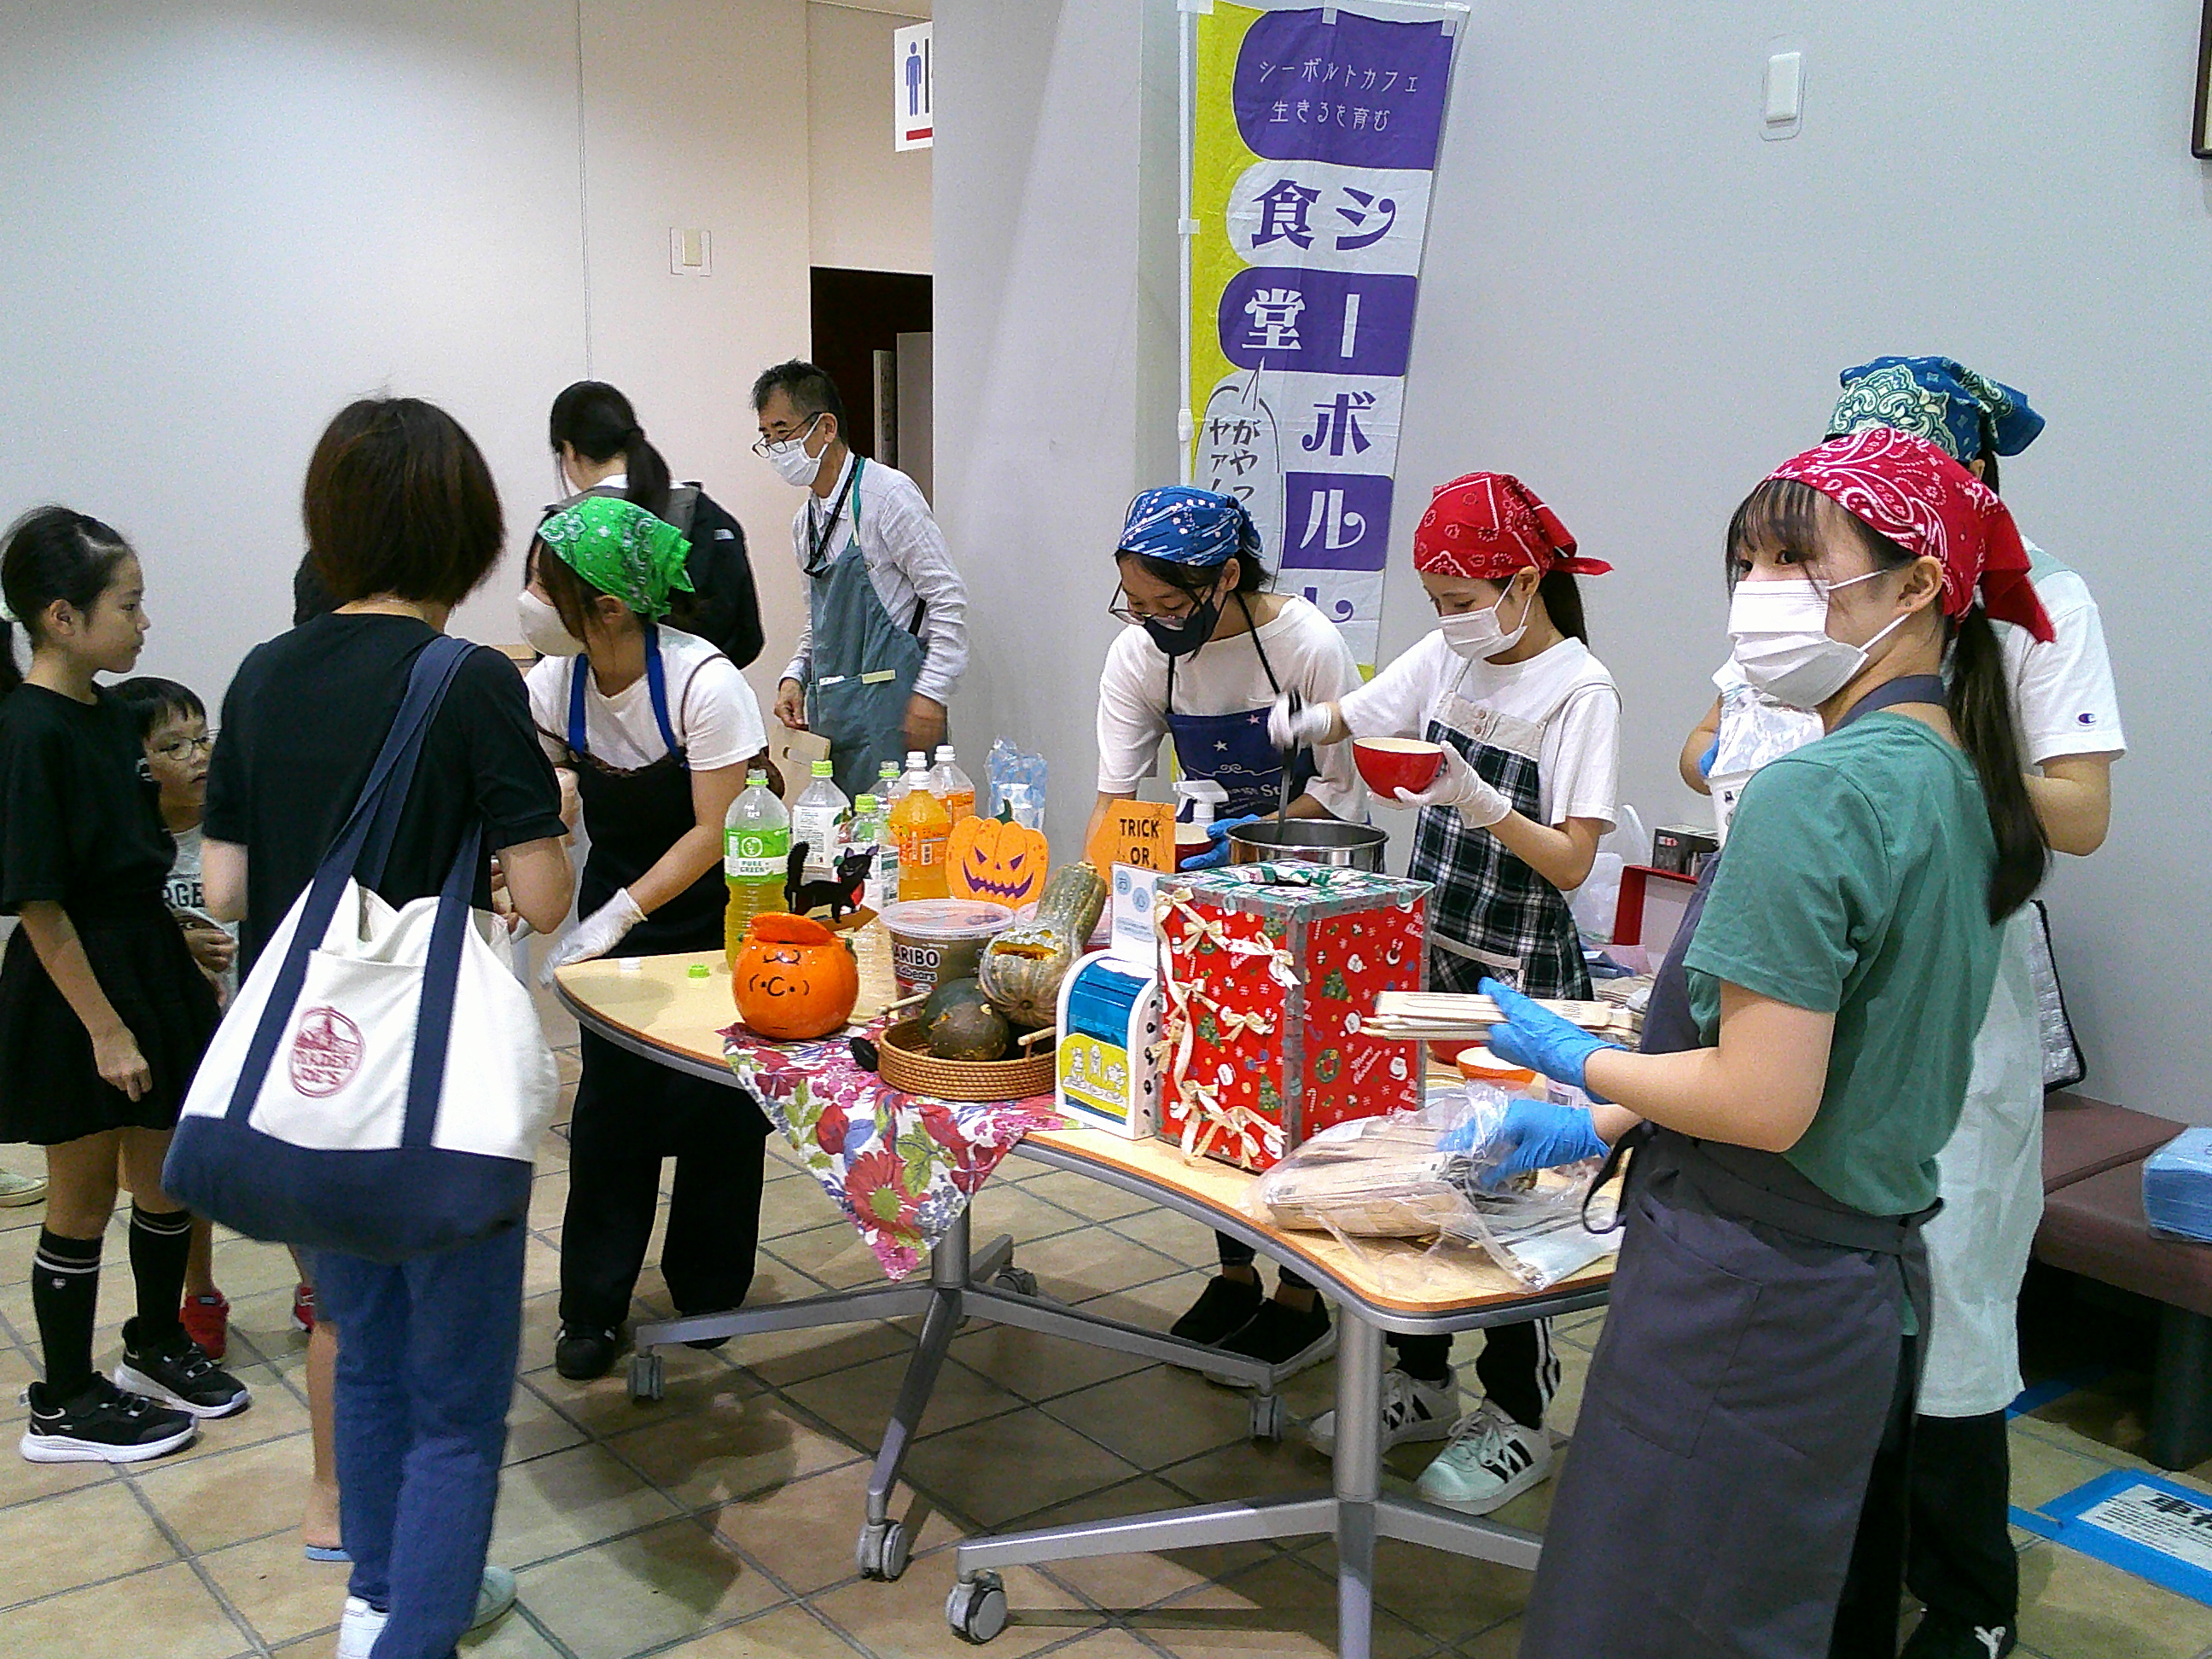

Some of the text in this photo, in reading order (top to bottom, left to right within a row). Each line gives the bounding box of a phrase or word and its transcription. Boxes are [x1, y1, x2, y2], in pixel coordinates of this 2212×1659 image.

[1259, 58, 1418, 92] シーボルトカフェ
[1269, 99, 1391, 131] 生きるを育む
[1242, 178, 1322, 351] 食堂
[1120, 818, 1160, 838] TRICK
[1130, 847, 1150, 865] OR
